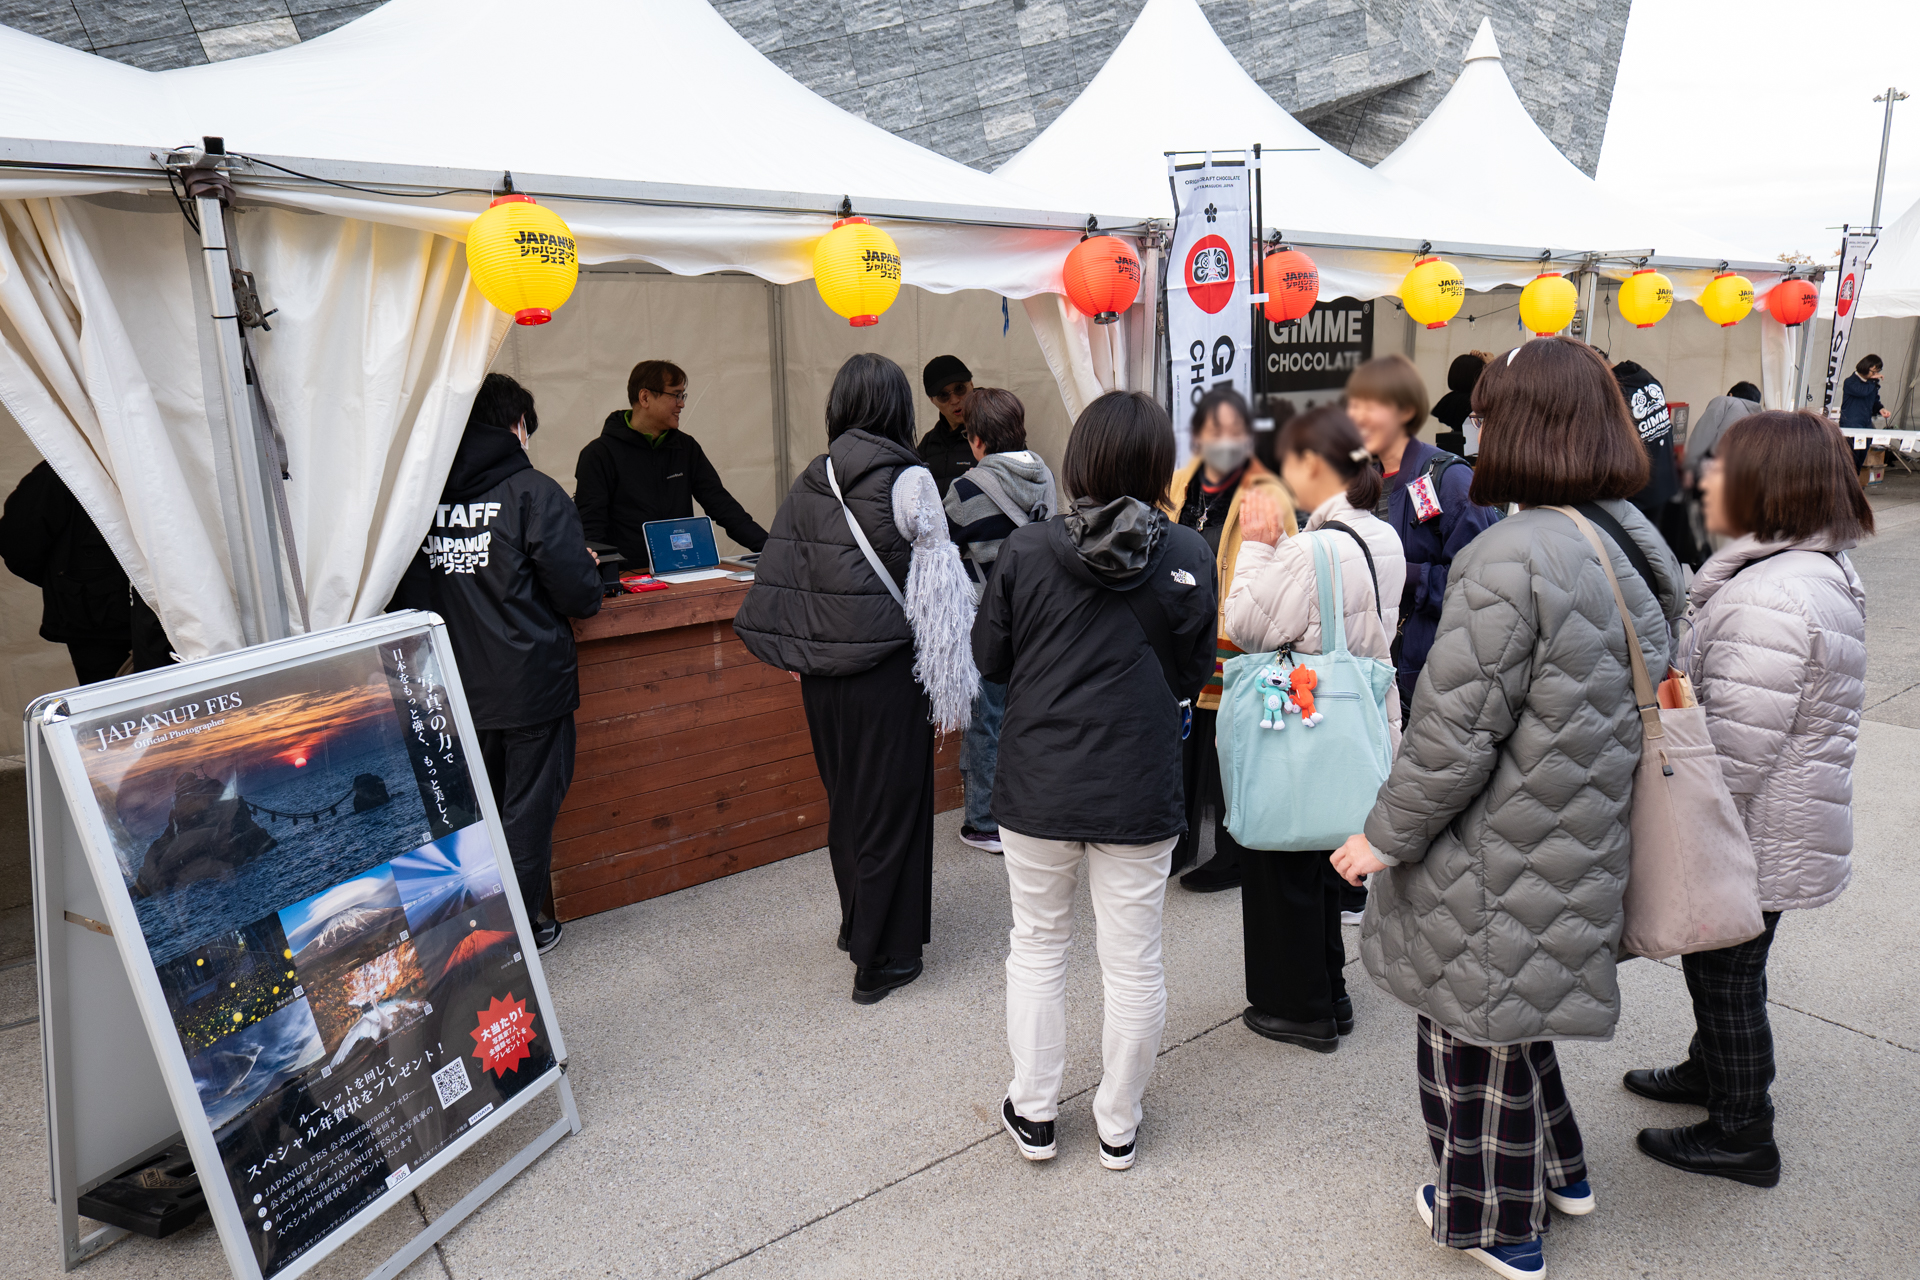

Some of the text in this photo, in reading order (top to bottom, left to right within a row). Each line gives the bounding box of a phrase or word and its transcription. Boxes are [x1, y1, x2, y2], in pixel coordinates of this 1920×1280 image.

[541, 254, 566, 266] フェス
[881, 270, 897, 280] フェス
[436, 502, 501, 528] TAFF
[421, 530, 492, 555] JAPANUP
[429, 551, 489, 570] ジャパンアップ
[443, 562, 476, 575] フェス
[96, 691, 243, 752] JAPANUP FES
[134, 718, 226, 749] Official Photographer
[417, 673, 454, 764] 写真の力で
[247, 1042, 444, 1182] スペシャル年賀状をプレゼント！
[299, 1056, 396, 1127] ルーレットを回して
[265, 1161, 308, 1197] JAPANUP
[310, 1148, 328, 1165] FES
[329, 1089, 416, 1151] 公式Instagramをフォロー
[270, 1116, 397, 1210] 公式写真家ブースでルーレットを回す
[277, 1134, 413, 1240] スペシャル年賀状をプレゼントいたします
